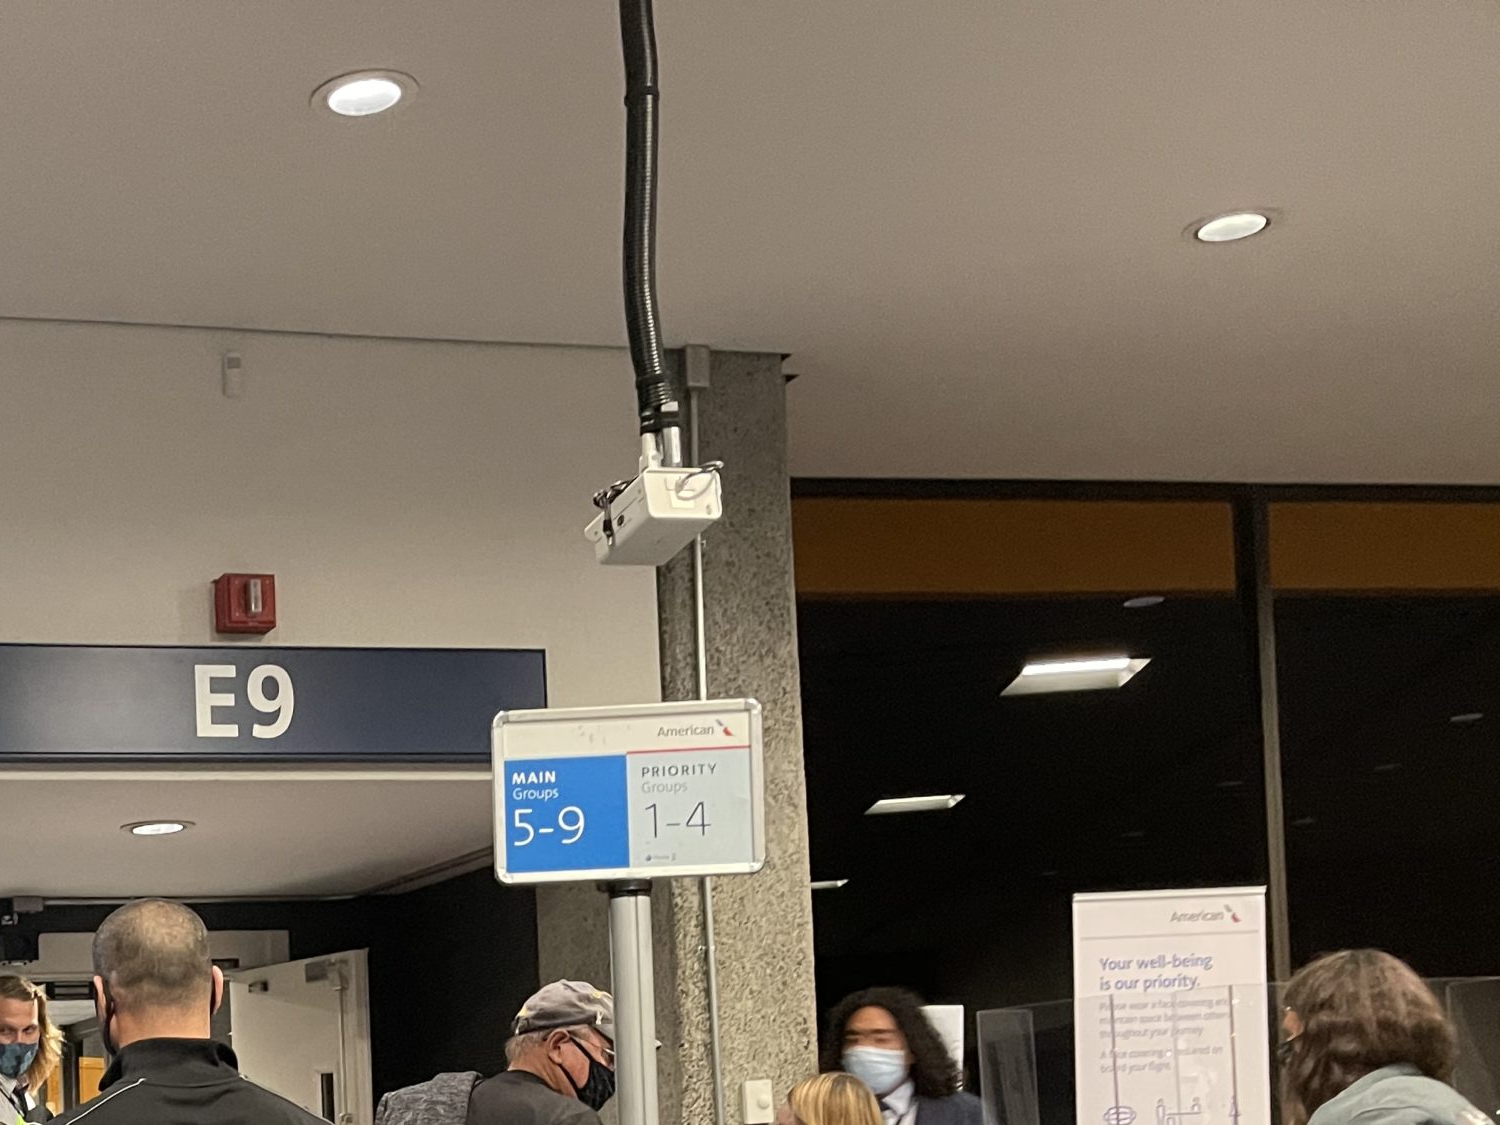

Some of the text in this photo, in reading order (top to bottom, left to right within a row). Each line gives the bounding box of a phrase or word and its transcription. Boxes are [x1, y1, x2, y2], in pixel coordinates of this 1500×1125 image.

[194, 664, 295, 739] E9
[657, 725, 715, 738] American
[512, 771, 556, 785] MAIN
[641, 763, 717, 778] PRIORITY
[512, 787, 560, 802] Groups
[641, 780, 688, 794] Groups
[513, 806, 586, 846] 5-9
[1170, 910, 1225, 922] American
[1100, 953, 1213, 971] Your well-being
[1100, 973, 1201, 992] is our priority.
